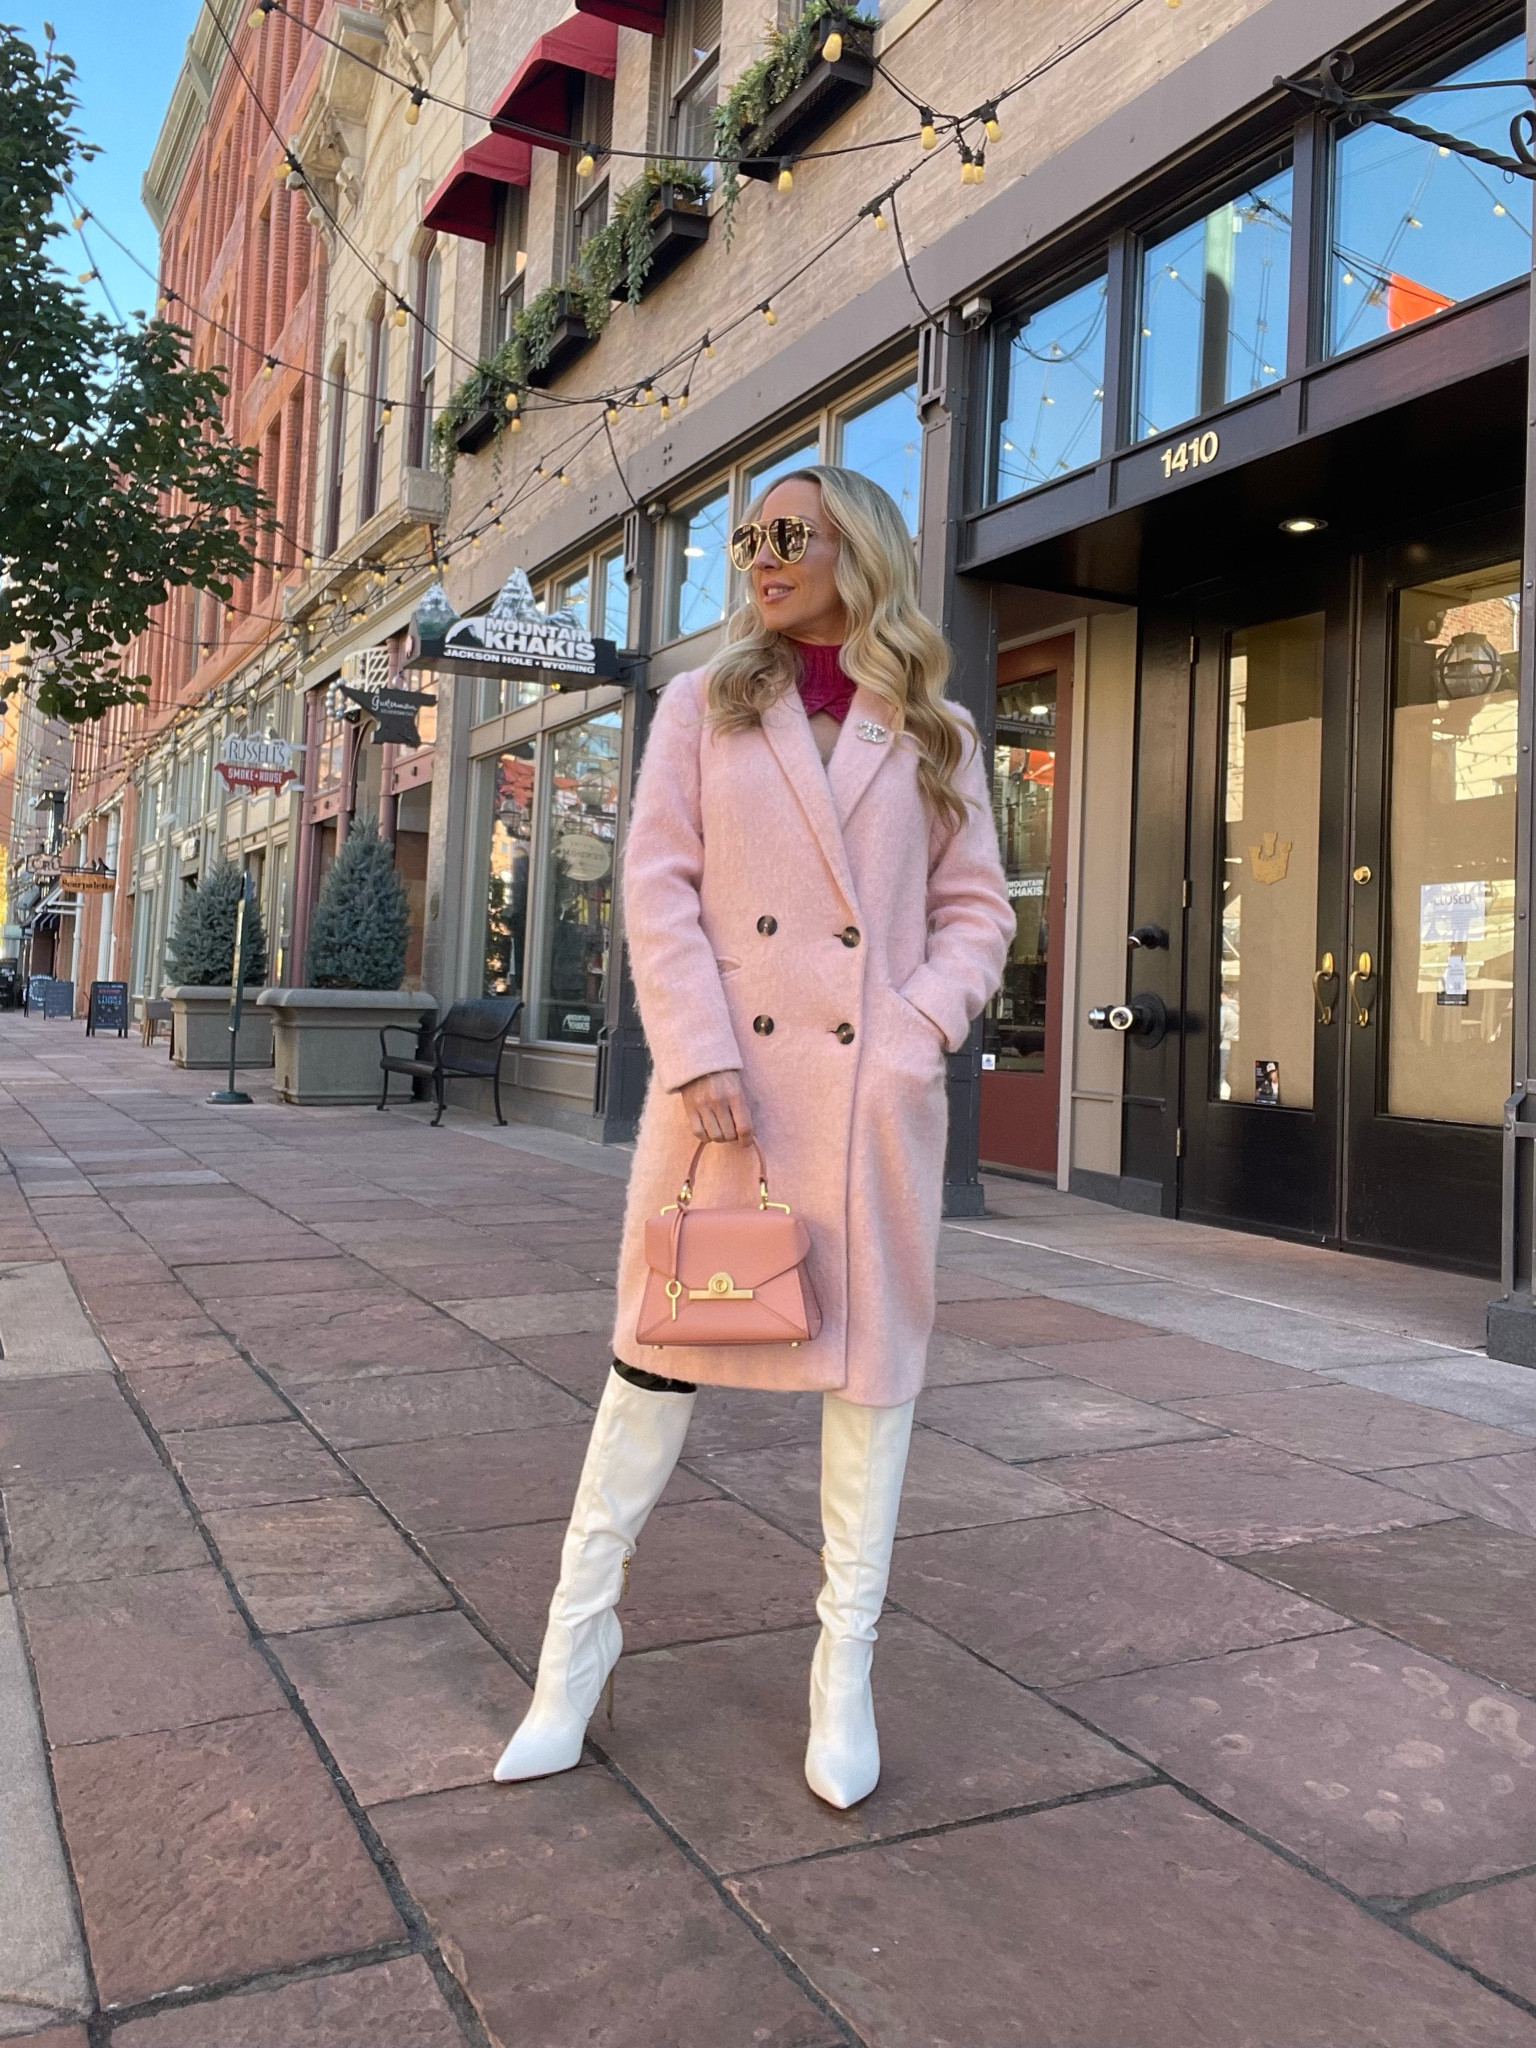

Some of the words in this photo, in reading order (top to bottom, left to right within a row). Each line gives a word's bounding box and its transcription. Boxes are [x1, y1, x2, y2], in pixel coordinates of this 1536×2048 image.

[1161, 431, 1219, 478] 1410
[486, 617, 592, 643] MOUNTAIN
[484, 631, 596, 661] KHAKIS
[443, 648, 500, 663] JACKSON
[502, 655, 533, 667] HOLE
[541, 660, 596, 674] WYOMING
[229, 740, 285, 764] RUSSELL'S
[228, 767, 254, 781] SMOKE
[258, 771, 283, 784] HOUSE
[1008, 879, 1044, 888] MOUNTAIN
[1008, 886, 1044, 897] KHAKIS
[1432, 894, 1473, 905] CLOSED
